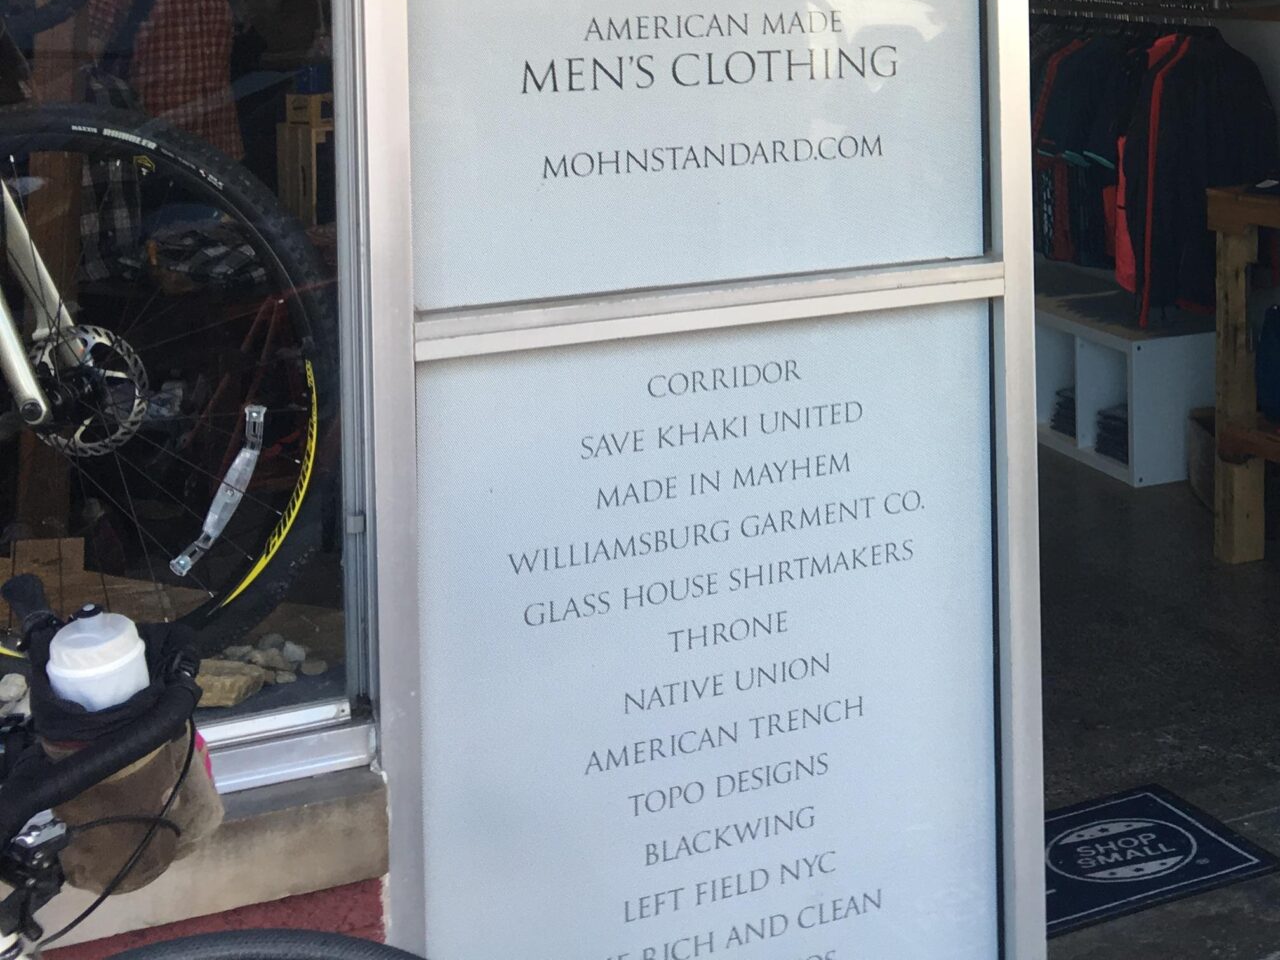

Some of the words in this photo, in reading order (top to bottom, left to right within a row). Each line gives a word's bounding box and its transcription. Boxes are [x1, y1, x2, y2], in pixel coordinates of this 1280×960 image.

[585, 12, 749, 41] AMERICAN
[762, 10, 843, 35] MADE
[520, 55, 655, 94] MEN'S
[671, 45, 898, 87] CLOTHING
[542, 135, 883, 180] MOHNSTANDARD.COM
[647, 359, 802, 399] CORRIDOR
[580, 429, 644, 460] SAVE
[657, 415, 748, 449] KHAKI
[759, 400, 863, 436] UNITED
[595, 474, 677, 510] MADE
[690, 470, 720, 496] IN
[732, 452, 851, 489] MAYHEM
[508, 520, 730, 575] WILLIAMSBURG
[740, 496, 874, 538] GARMENT
[883, 489, 925, 516] CO.
[523, 591, 610, 628] GLASS
[622, 572, 718, 610] HOUSE
[729, 539, 914, 593] SHIRTMAKERS
[668, 611, 788, 653] THRONE
[624, 674, 724, 715] NATIVE
[735, 652, 831, 691] UNION
[585, 721, 738, 775] AMERICAN
[749, 696, 864, 739] TRENCH
[628, 781, 704, 818] TOPO
[716, 752, 829, 798] DESIGNS
[645, 806, 816, 866] BLACKWING
[1077, 833, 1157, 857] SHOP
[1077, 843, 1176, 869] SMALL
[624, 888, 685, 923] LEFT
[695, 868, 769, 906] FIELD
[780, 851, 837, 885] NYC
[643, 931, 714, 960] RICH
[726, 913, 789, 949] AND
[797, 889, 882, 929] CLEAN
